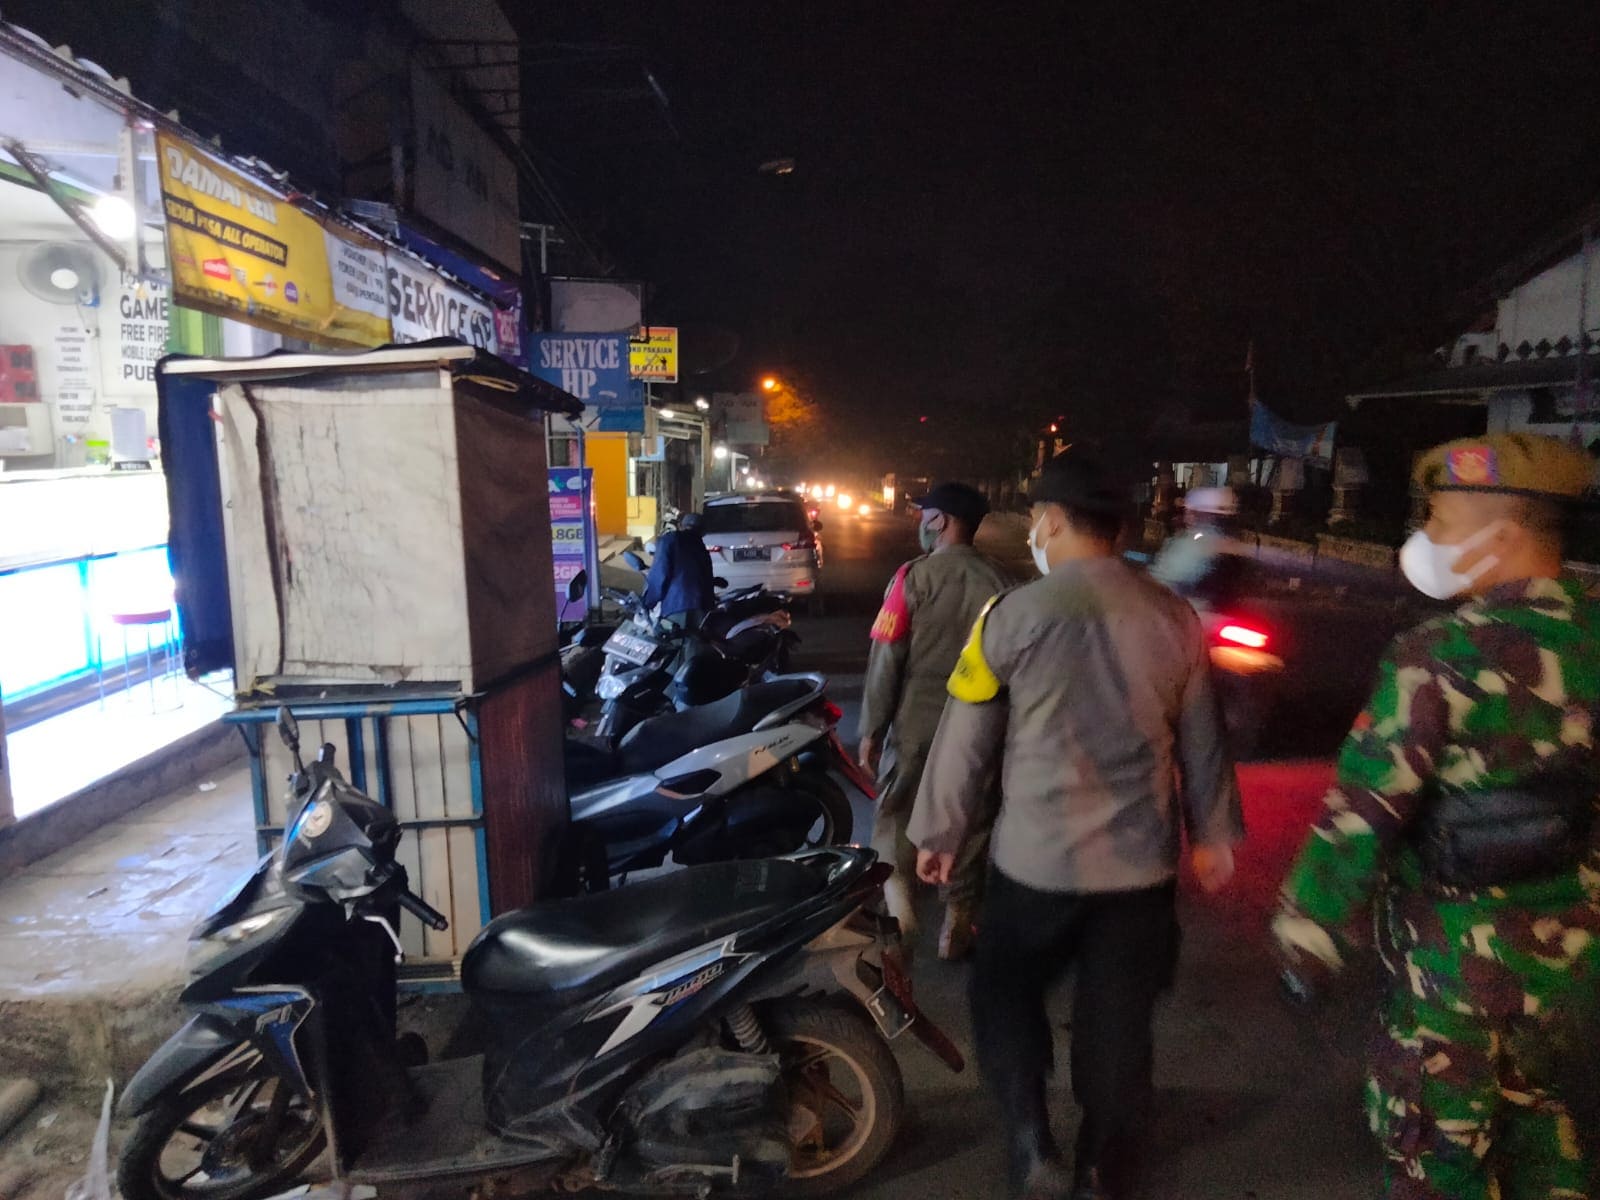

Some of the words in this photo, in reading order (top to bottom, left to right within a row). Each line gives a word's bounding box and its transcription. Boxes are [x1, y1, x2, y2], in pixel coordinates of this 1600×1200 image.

[120, 294, 169, 320] GAME
[387, 267, 468, 343] SERVICE
[120, 323, 145, 341] FREE
[540, 338, 620, 369] SERVICE
[562, 369, 597, 399] HP
